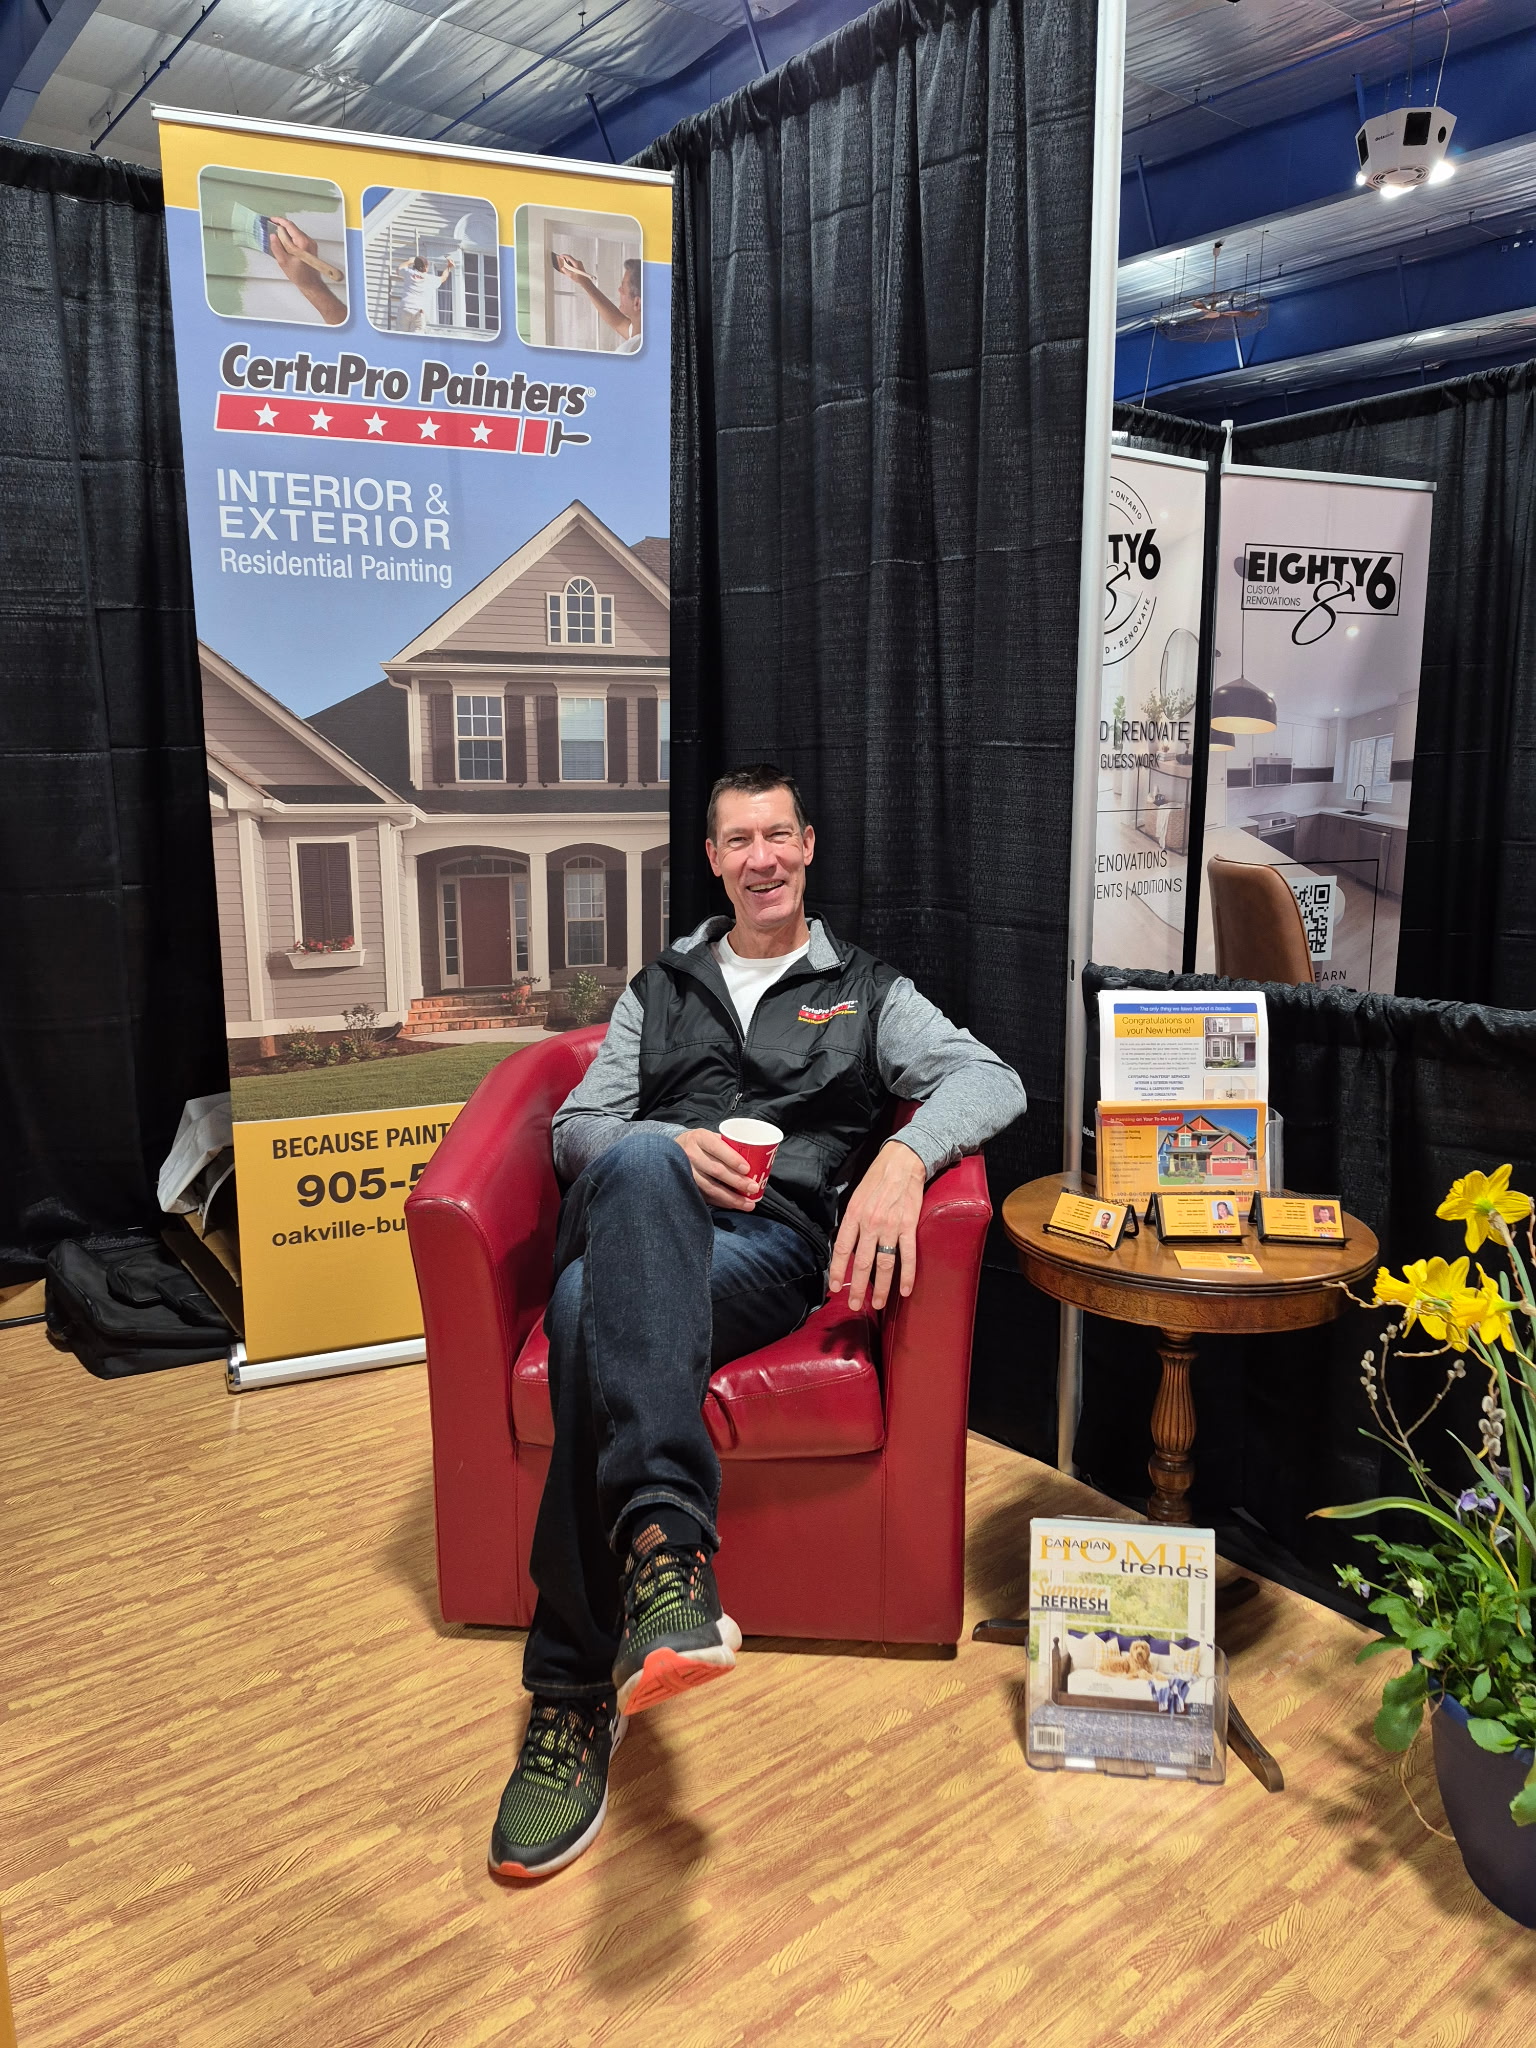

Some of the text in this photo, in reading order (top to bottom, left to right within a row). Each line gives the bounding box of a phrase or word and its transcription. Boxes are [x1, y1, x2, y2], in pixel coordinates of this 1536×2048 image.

[220, 342, 410, 401] CertaPro
[216, 468, 451, 516] INTERIOR &
[1115, 490, 1143, 520] ONTARIO
[218, 506, 451, 550] EXTERIOR
[220, 547, 453, 589] Residential Painting
[1107, 529, 1161, 581] TY6
[1246, 585, 1280, 595] CUSTOM
[1248, 551, 1396, 611] EIGHTY6
[1246, 596, 1301, 607] RENOVATIONS
[1118, 598, 1151, 648] RENOVATE
[1121, 720, 1190, 741] RENOVATE
[1100, 753, 1161, 769] GUESSWORK
[1094, 850, 1168, 874] ENOVATIONS
[1094, 878, 1183, 900] ENTS ADDITIONS
[1314, 970, 1347, 982] EARN
[1121, 1016, 1195, 1026] Congratulations on
[1126, 1028, 1144, 1036] your
[271, 1122, 452, 1159] BECAUSE PAINT
[296, 1162, 429, 1208] 905-5
[271, 1216, 406, 1247] oakville-bu
[1038, 1535, 1206, 1568] HOME
[1044, 1538, 1111, 1550] CANADIAN
[1120, 1558, 1209, 1580] trends
[1041, 1595, 1108, 1611] REFRESH
